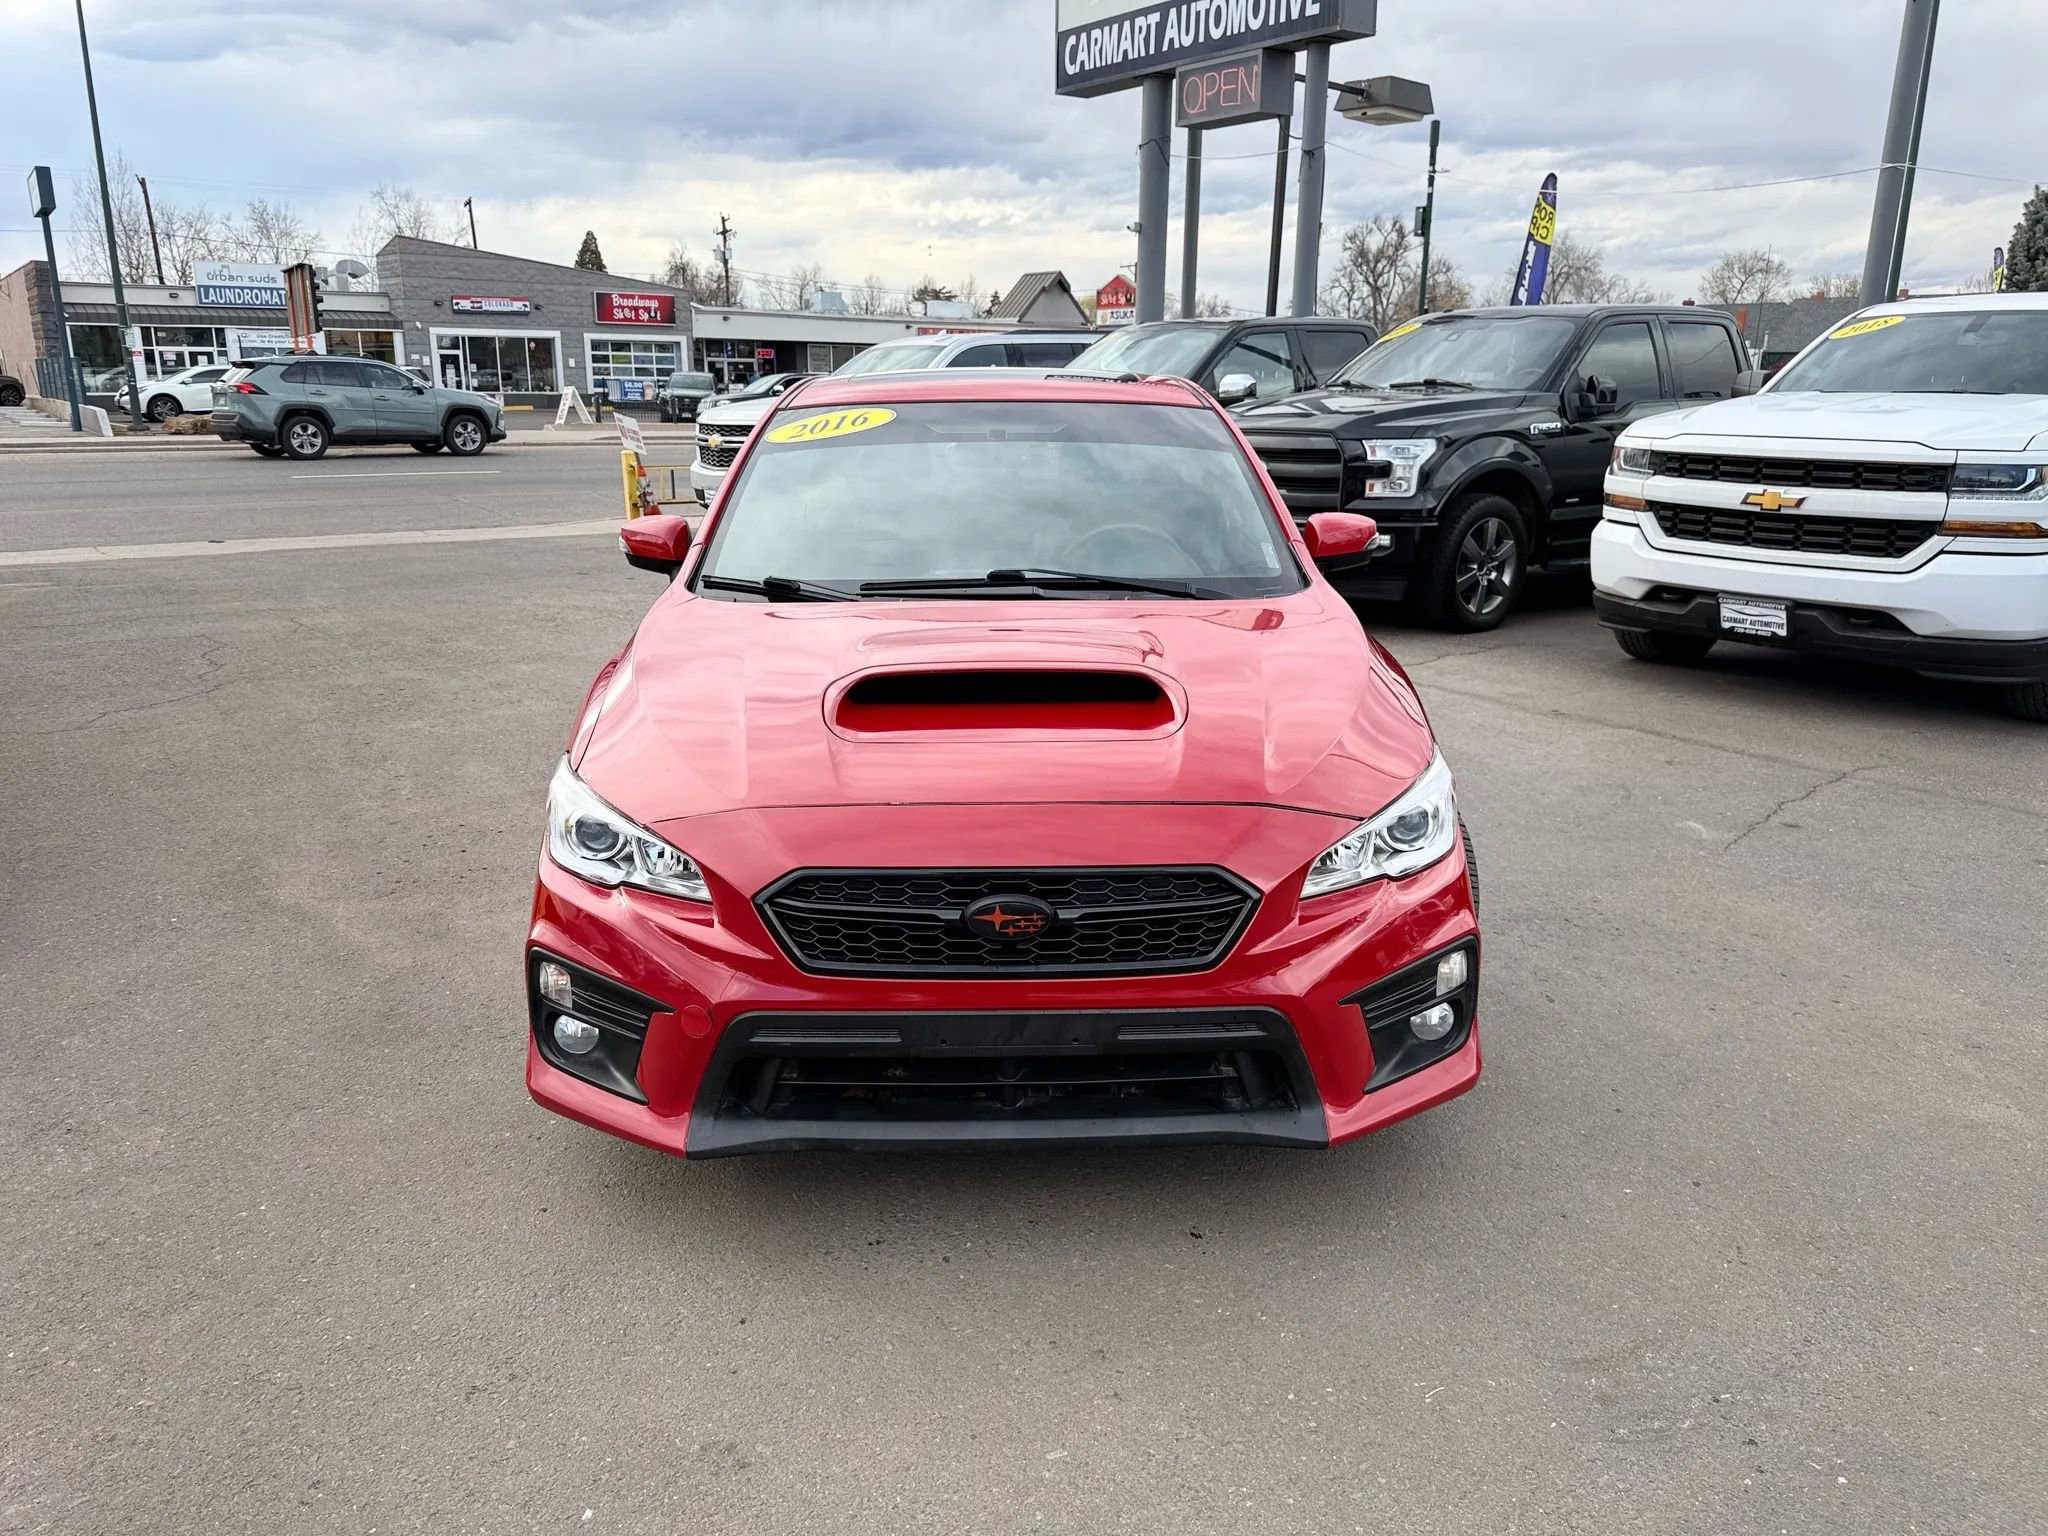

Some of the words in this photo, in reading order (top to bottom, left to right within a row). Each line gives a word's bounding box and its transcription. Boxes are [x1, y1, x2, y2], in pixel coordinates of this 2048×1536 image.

[1064, 11, 1161, 76] CARMART
[1183, 64, 1259, 114] OPEN
[206, 266, 243, 282] urban
[248, 273, 278, 284] suds
[200, 287, 287, 306] LAUNDROMAT
[611, 294, 659, 308] Broadways
[787, 411, 873, 440] 2016
[1722, 615, 1749, 625] CARMART
[1749, 620, 1785, 630] AUTOMOTIVE
